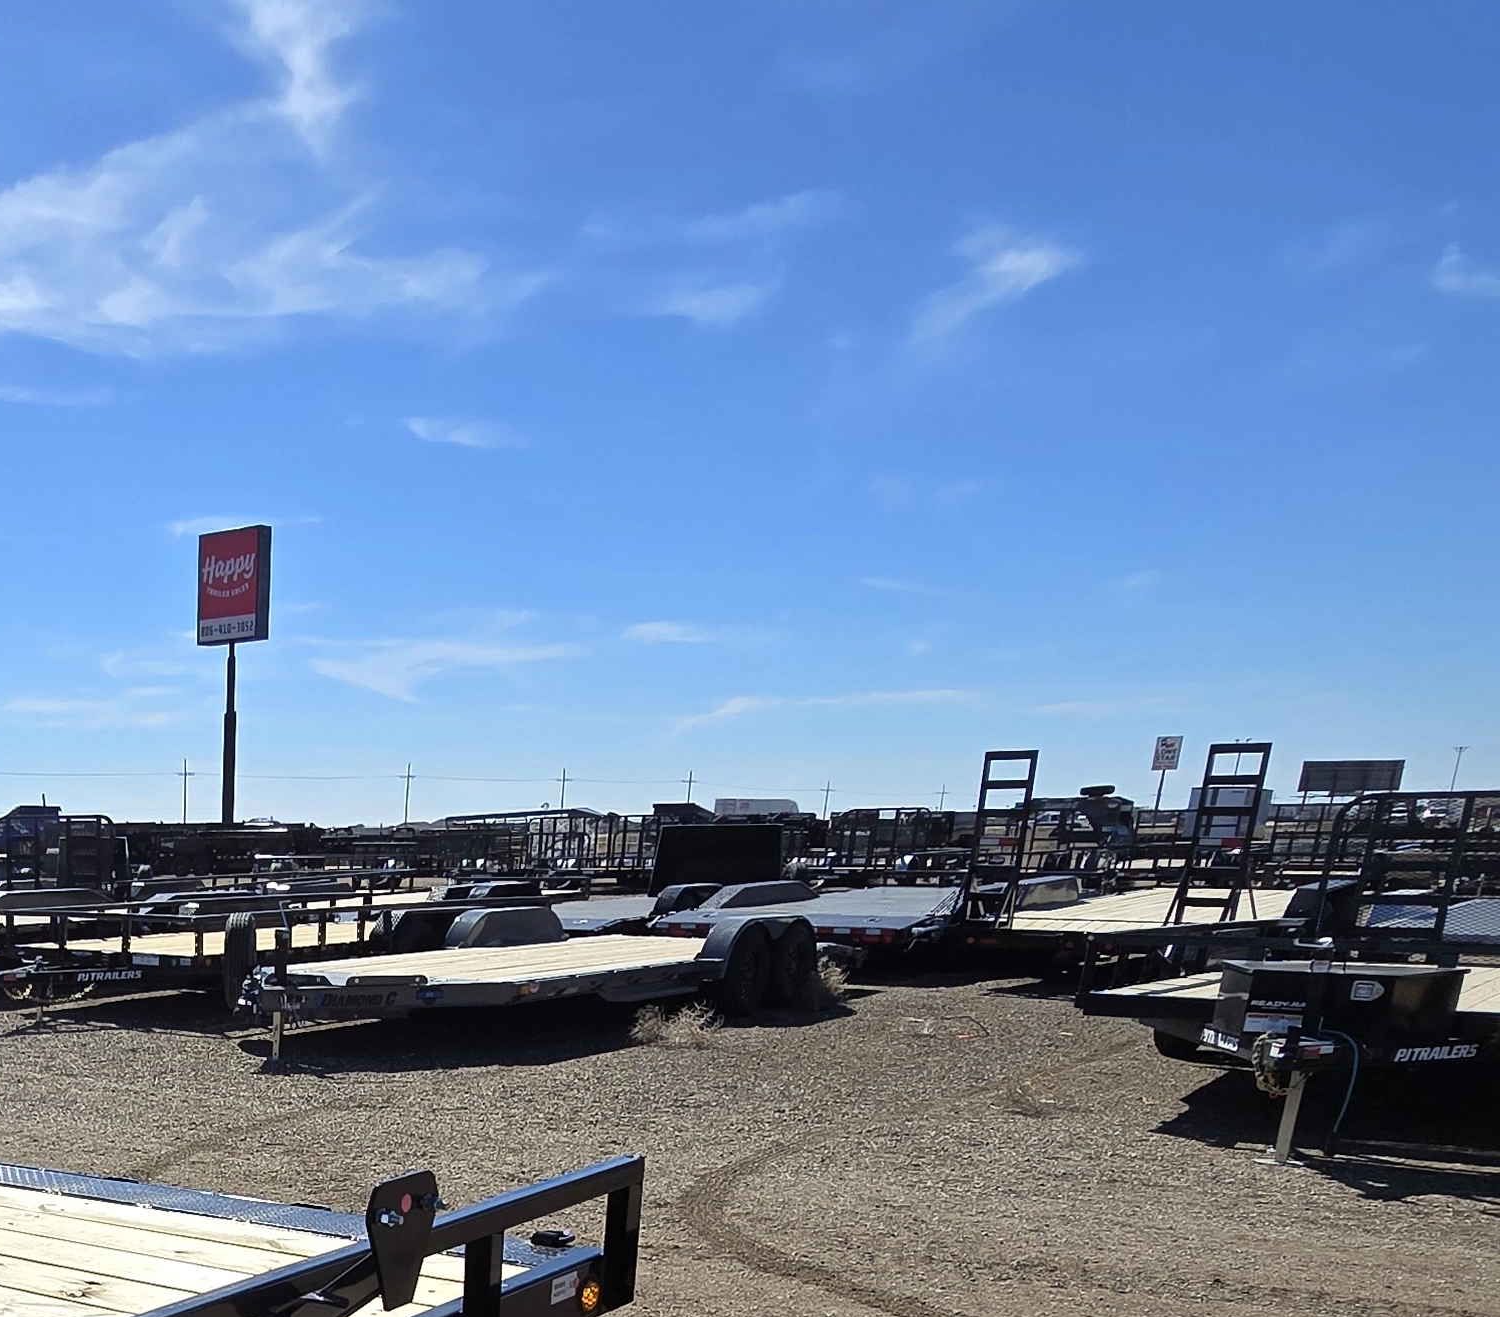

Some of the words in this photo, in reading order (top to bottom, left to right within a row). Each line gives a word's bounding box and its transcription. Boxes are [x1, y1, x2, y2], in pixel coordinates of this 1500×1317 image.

[202, 553, 256, 585] Happy
[206, 587, 230, 598] TRAILER
[231, 582, 249, 597] SALES
[77, 973, 89, 982] PJ
[90, 970, 142, 981] TRAILERS
[385, 991, 398, 1006] C
[1394, 1048, 1413, 1063] PJ
[1411, 1044, 1479, 1061] TRAILERS
